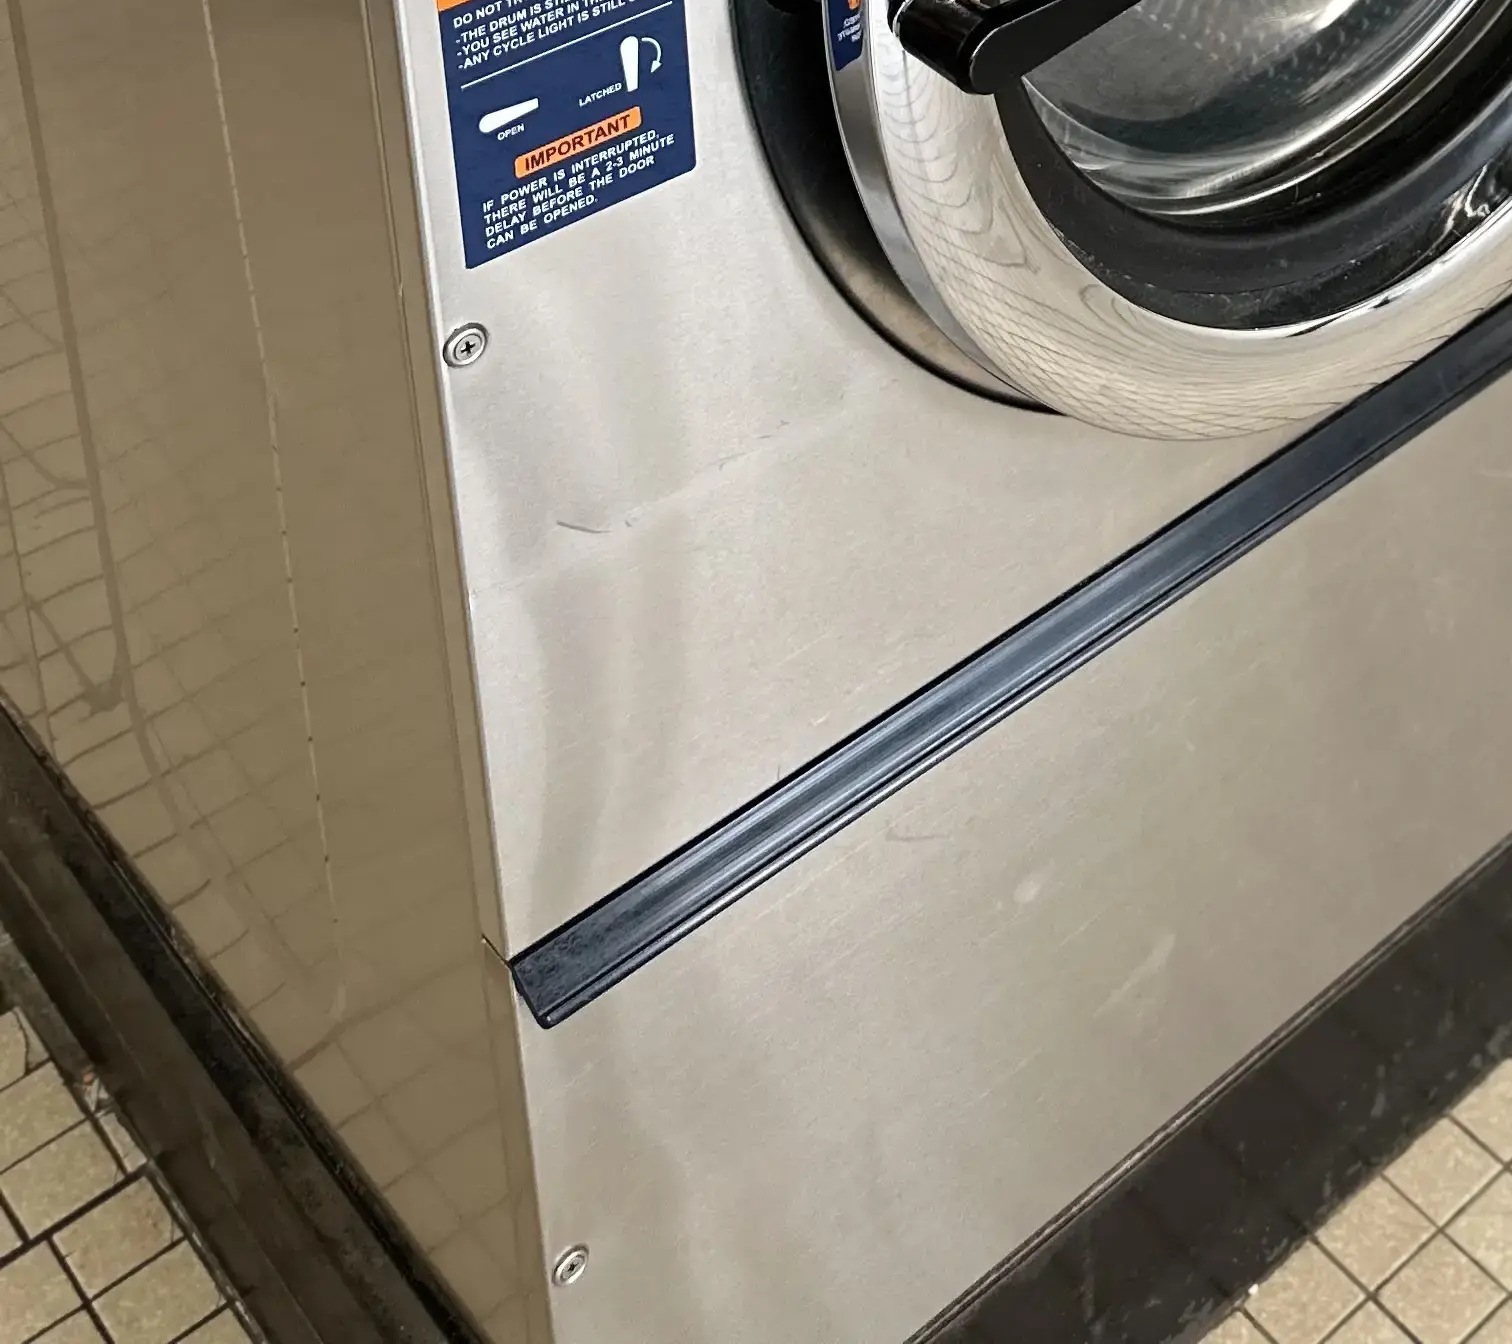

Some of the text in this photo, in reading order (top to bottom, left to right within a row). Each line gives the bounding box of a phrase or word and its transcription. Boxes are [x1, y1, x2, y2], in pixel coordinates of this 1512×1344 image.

[453, 13, 472, 28] DO
[476, 3, 501, 20] NOT
[456, 25, 486, 44] -THE
[489, 10, 527, 32] DRUM
[530, 4, 542, 16] IS
[457, 37, 489, 57] -YOU
[493, 25, 517, 44] SEE
[520, 10, 564, 33] WATER
[567, 3, 579, 14] IN
[459, 51, 489, 70] -ANY
[494, 32, 535, 56] CYCLE
[538, 17, 573, 39] LIGHT
[578, 11, 589, 23] IS
[579, 82, 622, 106] LATCHED
[498, 124, 524, 140] OPEN
[525, 114, 630, 171] IMPORTANT
[483, 130, 659, 213] IF POWER IS INTERRUPTED,
[484, 134, 674, 225] THERE WILL BE A 2-3 MINUTE
[486, 156, 654, 237] DELAY BEFORE THE DOOR
[487, 195, 598, 249] CAN BE OPENED.
